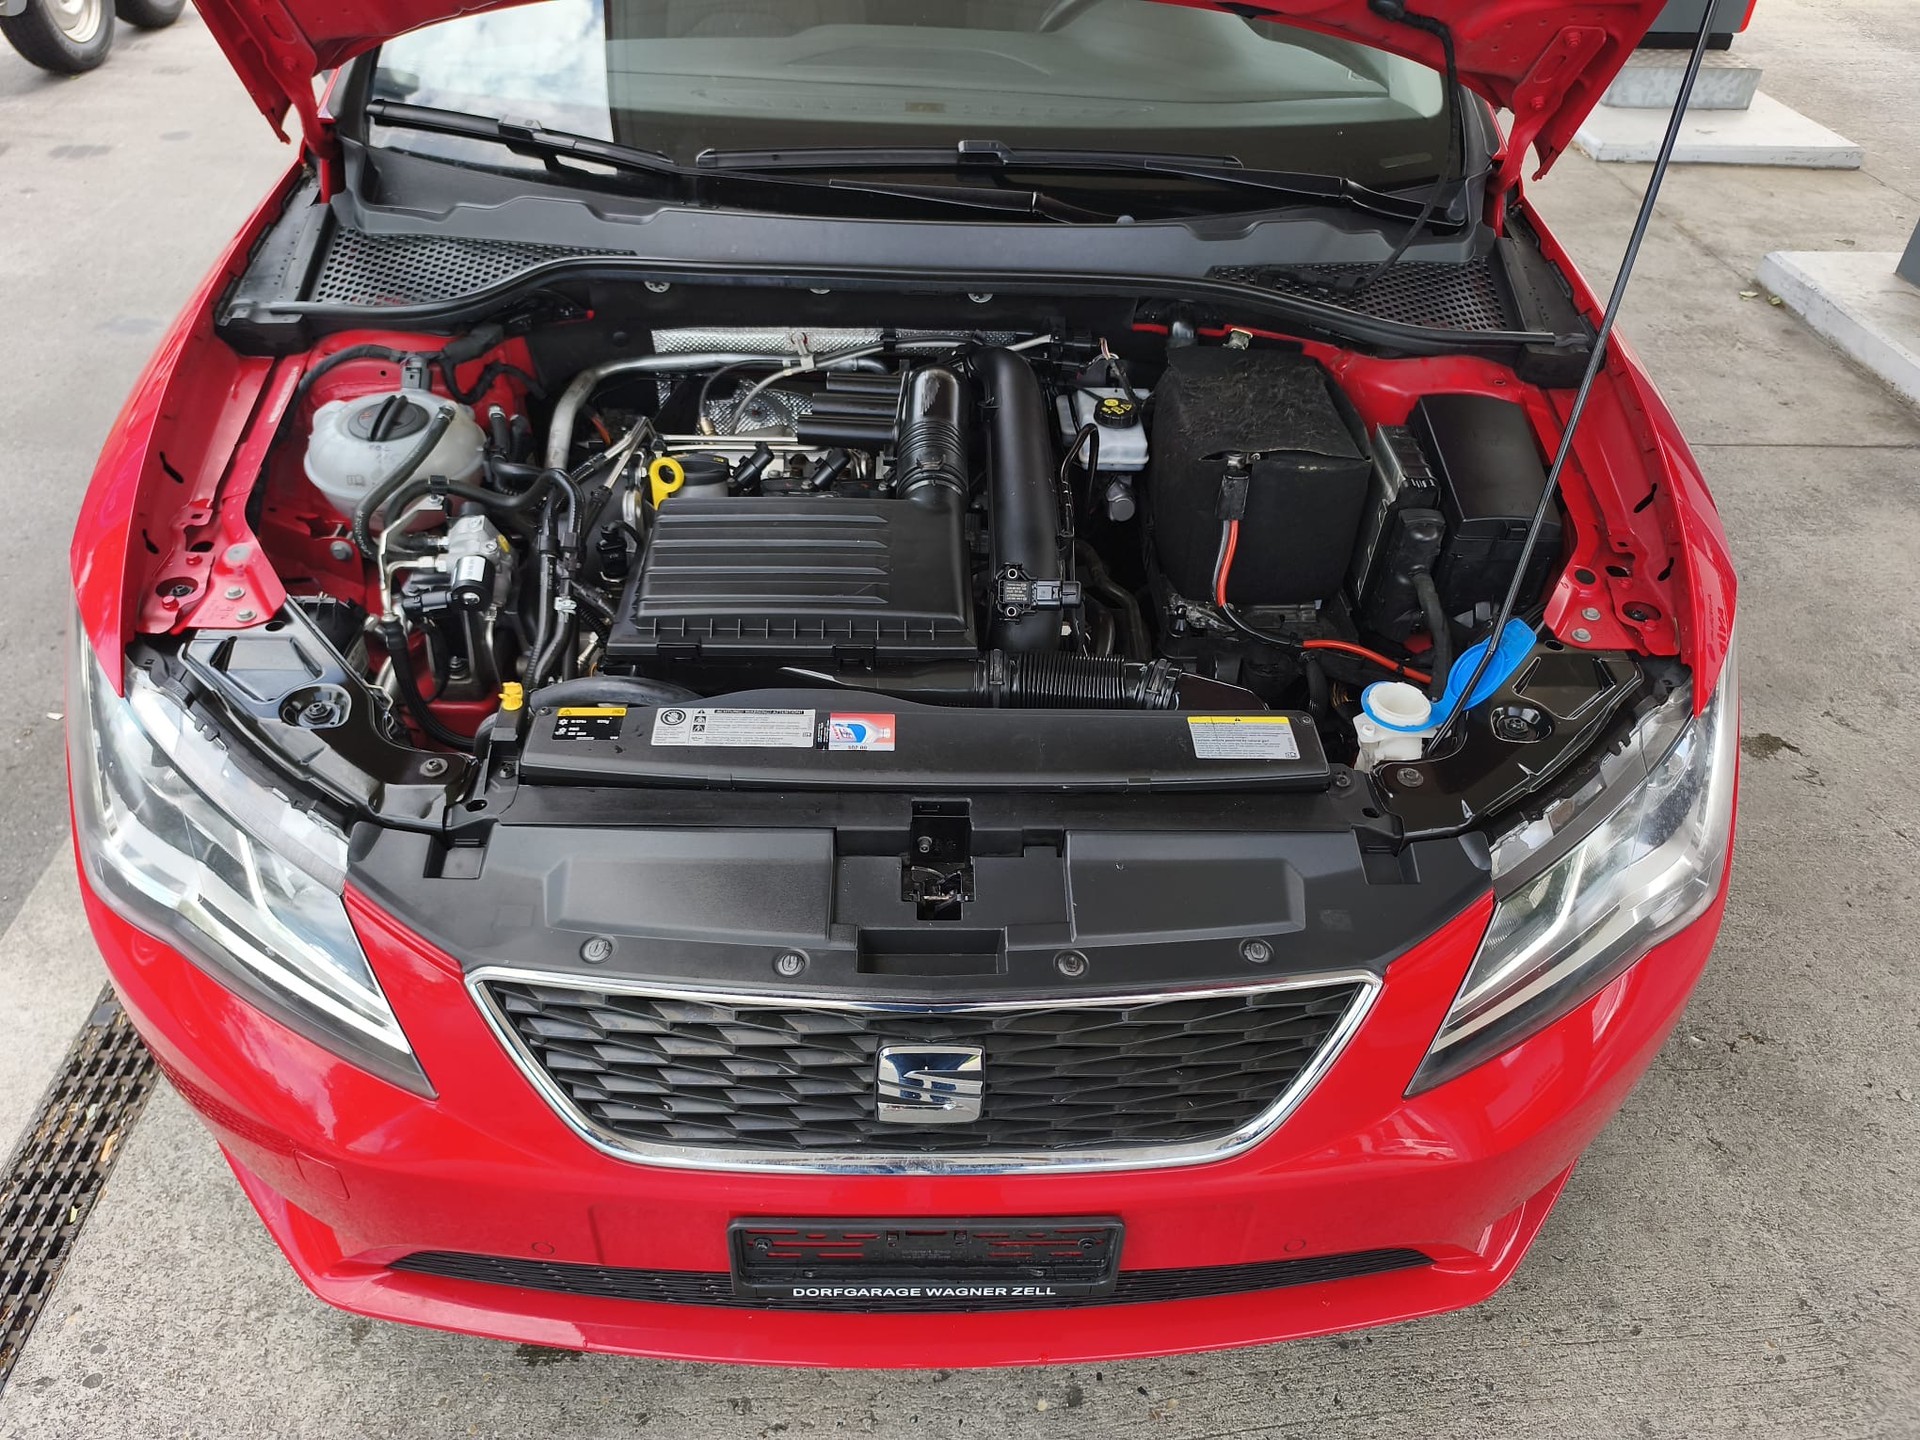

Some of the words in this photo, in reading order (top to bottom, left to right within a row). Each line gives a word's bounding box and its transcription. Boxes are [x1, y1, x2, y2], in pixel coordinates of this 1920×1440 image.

[792, 1287, 922, 1297] DORFGARAGE
[925, 1287, 1007, 1297] WAGNER
[1010, 1286, 1057, 1296] ZELL
